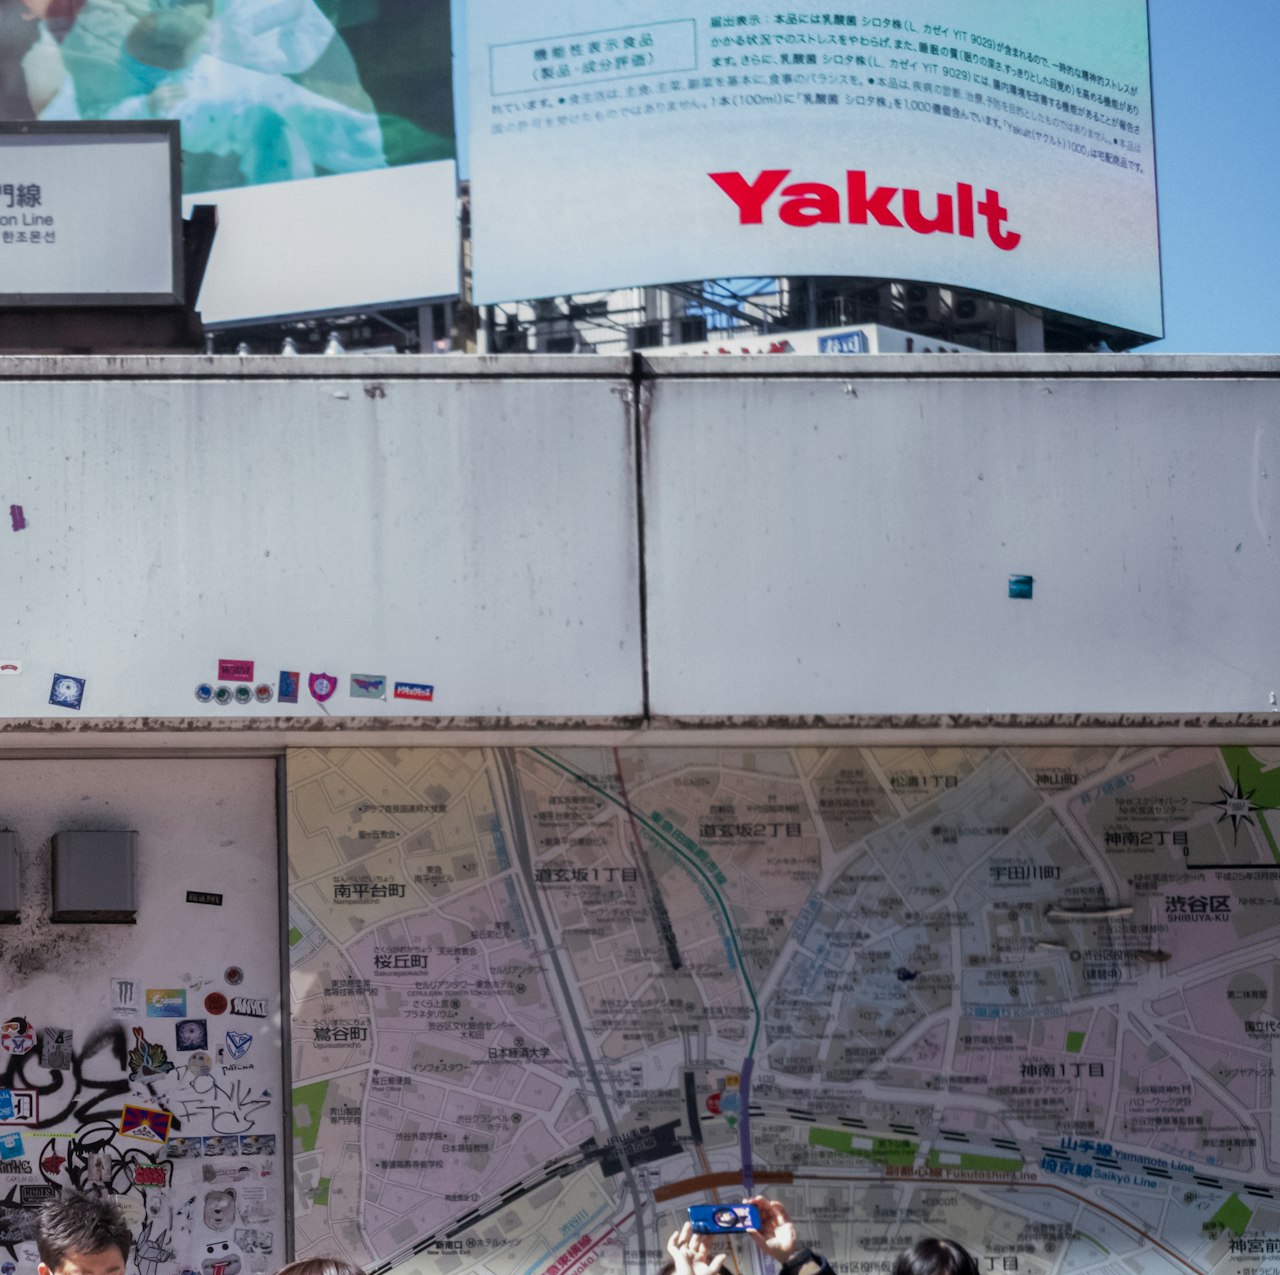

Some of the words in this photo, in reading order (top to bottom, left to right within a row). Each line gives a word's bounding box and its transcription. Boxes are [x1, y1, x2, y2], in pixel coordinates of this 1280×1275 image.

[953, 29, 968, 42] YIT
[922, 62, 939, 74] YIT
[707, 167, 1022, 252] Yakult
[22, 212, 54, 228] Line
[699, 823, 802, 839] 道玄坂2丁目
[1104, 830, 1189, 846] 神南2丁目
[534, 867, 638, 884] 道玄坂1丁目
[989, 865, 1062, 881] 宇田川町
[333, 883, 407, 899] 南平台町
[1165, 895, 1232, 913] 渋谷区
[1168, 913, 1229, 923] SHIBUYA-KU
[373, 953, 429, 970] 桜丘町
[314, 1026, 369, 1042] 鶯谷町
[1019, 1061, 1105, 1079] 神南1丁目
[1060, 1136, 1114, 1158] 山手線
[1114, 1149, 1169, 1168] Yamanote
[1170, 1159, 1196, 1173] Line
[945, 1169, 1009, 1180] Fukutoshin
[1011, 1170, 1039, 1181] Line
[1040, 1158, 1094, 1179] 埼京線
[1133, 1176, 1158, 1190] Line
[559, 1208, 589, 1238] 渋谷川
[434, 1239, 464, 1250] 新南口
[476, 1238, 523, 1248] ホテルメッツ
